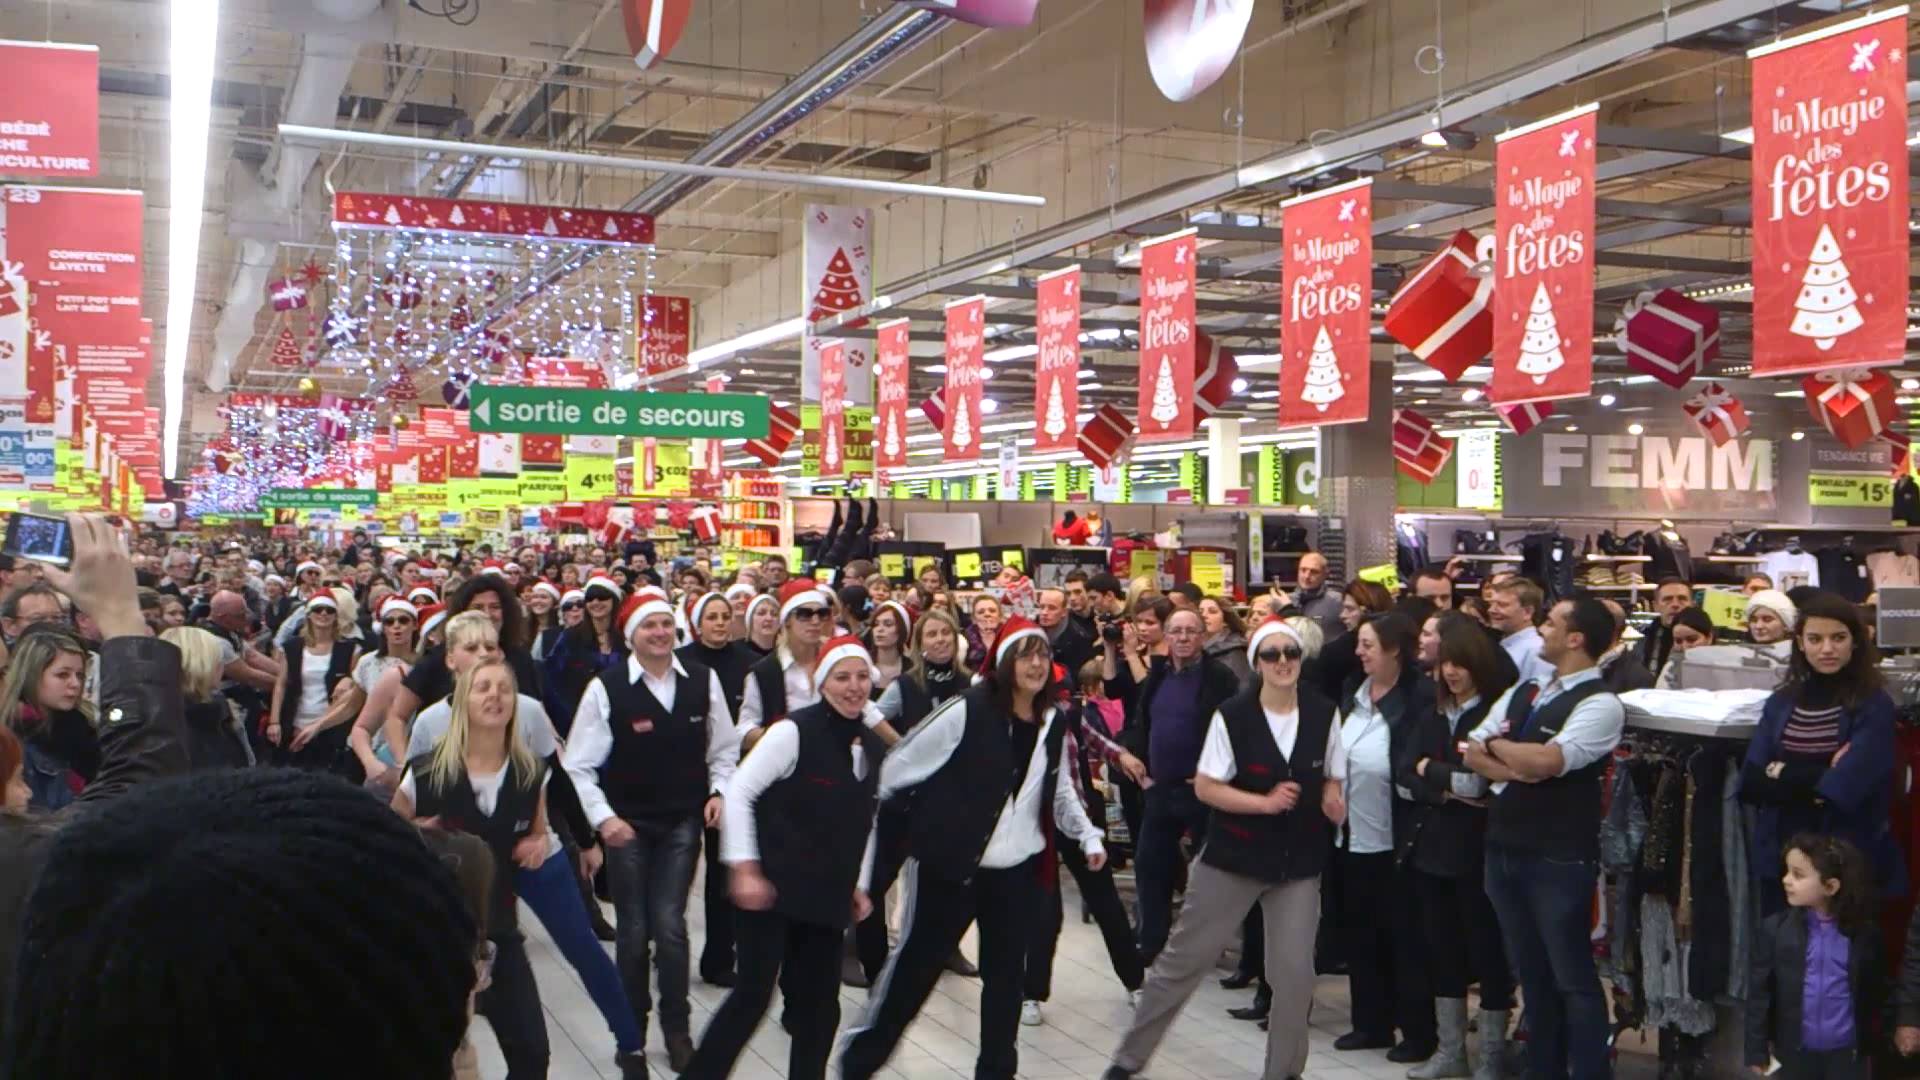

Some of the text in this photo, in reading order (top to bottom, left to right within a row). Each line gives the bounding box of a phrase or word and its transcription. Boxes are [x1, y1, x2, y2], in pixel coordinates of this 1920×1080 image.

[1771, 95, 1885, 139] la Magie
[1808, 137, 1842, 165] des
[1508, 176, 1582, 211] la Magie
[1768, 153, 1890, 221] fêtes
[1530, 211, 1555, 232] des
[1304, 236, 1360, 265] Magie
[1504, 223, 1584, 279] fêtes
[1312, 265, 1334, 283] des
[1290, 276, 1362, 322] fêtes
[1144, 308, 1190, 350] fêtes
[499, 399, 746, 429] sortie de secours
[1818, 450, 1867, 463] TENDANCE
